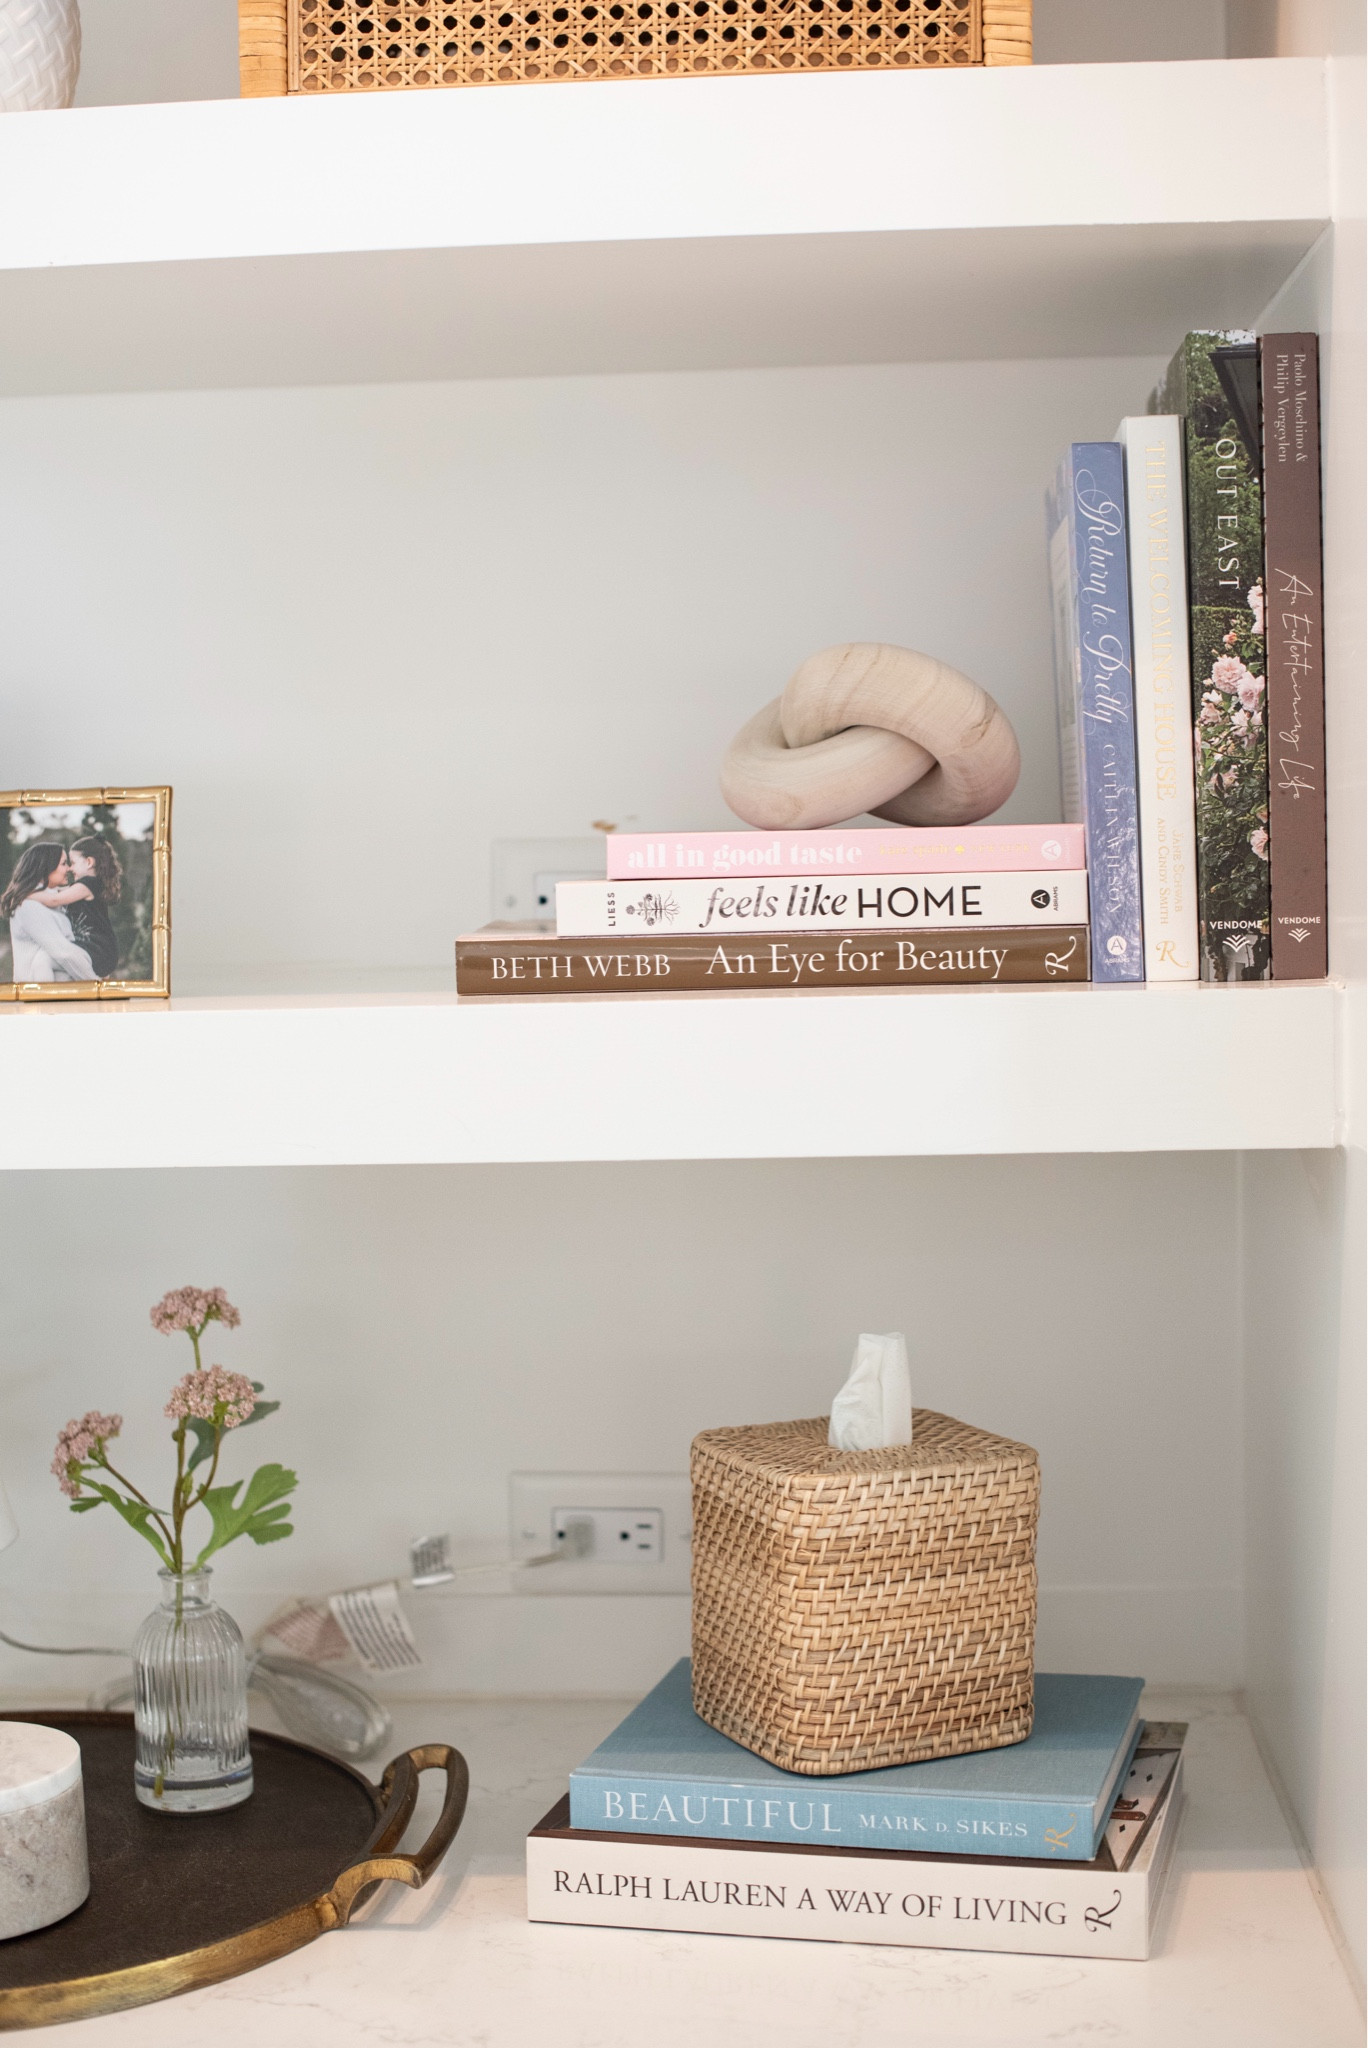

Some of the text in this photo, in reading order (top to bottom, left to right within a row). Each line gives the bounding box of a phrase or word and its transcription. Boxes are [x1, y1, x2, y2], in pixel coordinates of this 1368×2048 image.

[1273, 354, 1290, 462] Philip Vergeylen
[1294, 354, 1308, 462] Paolo Moschino &
[1215, 438, 1240, 590] OUT EAST
[1075, 469, 1132, 730] Return to Pretty
[1145, 440, 1176, 800] THE WELCOMING HOUSE
[1275, 568, 1315, 799] An Entertaining Life
[628, 841, 863, 872] all in good taste
[1103, 744, 1122, 913] CAITLIN WILSON
[607, 892, 616, 927] LIESS
[698, 884, 982, 928] feels like HOME
[1209, 920, 1263, 930] VENDOME
[1278, 916, 1321, 925] VENDOME
[491, 939, 1008, 983] BETH WEBB An Eye for Beauty
[603, 1790, 842, 1833] BEAUTIFUL
[859, 1813, 928, 1832] MARK
[956, 1819, 1028, 1837] SIKES
[553, 1870, 1067, 1926] RALPH LAUREN A WAY OF LIVING
